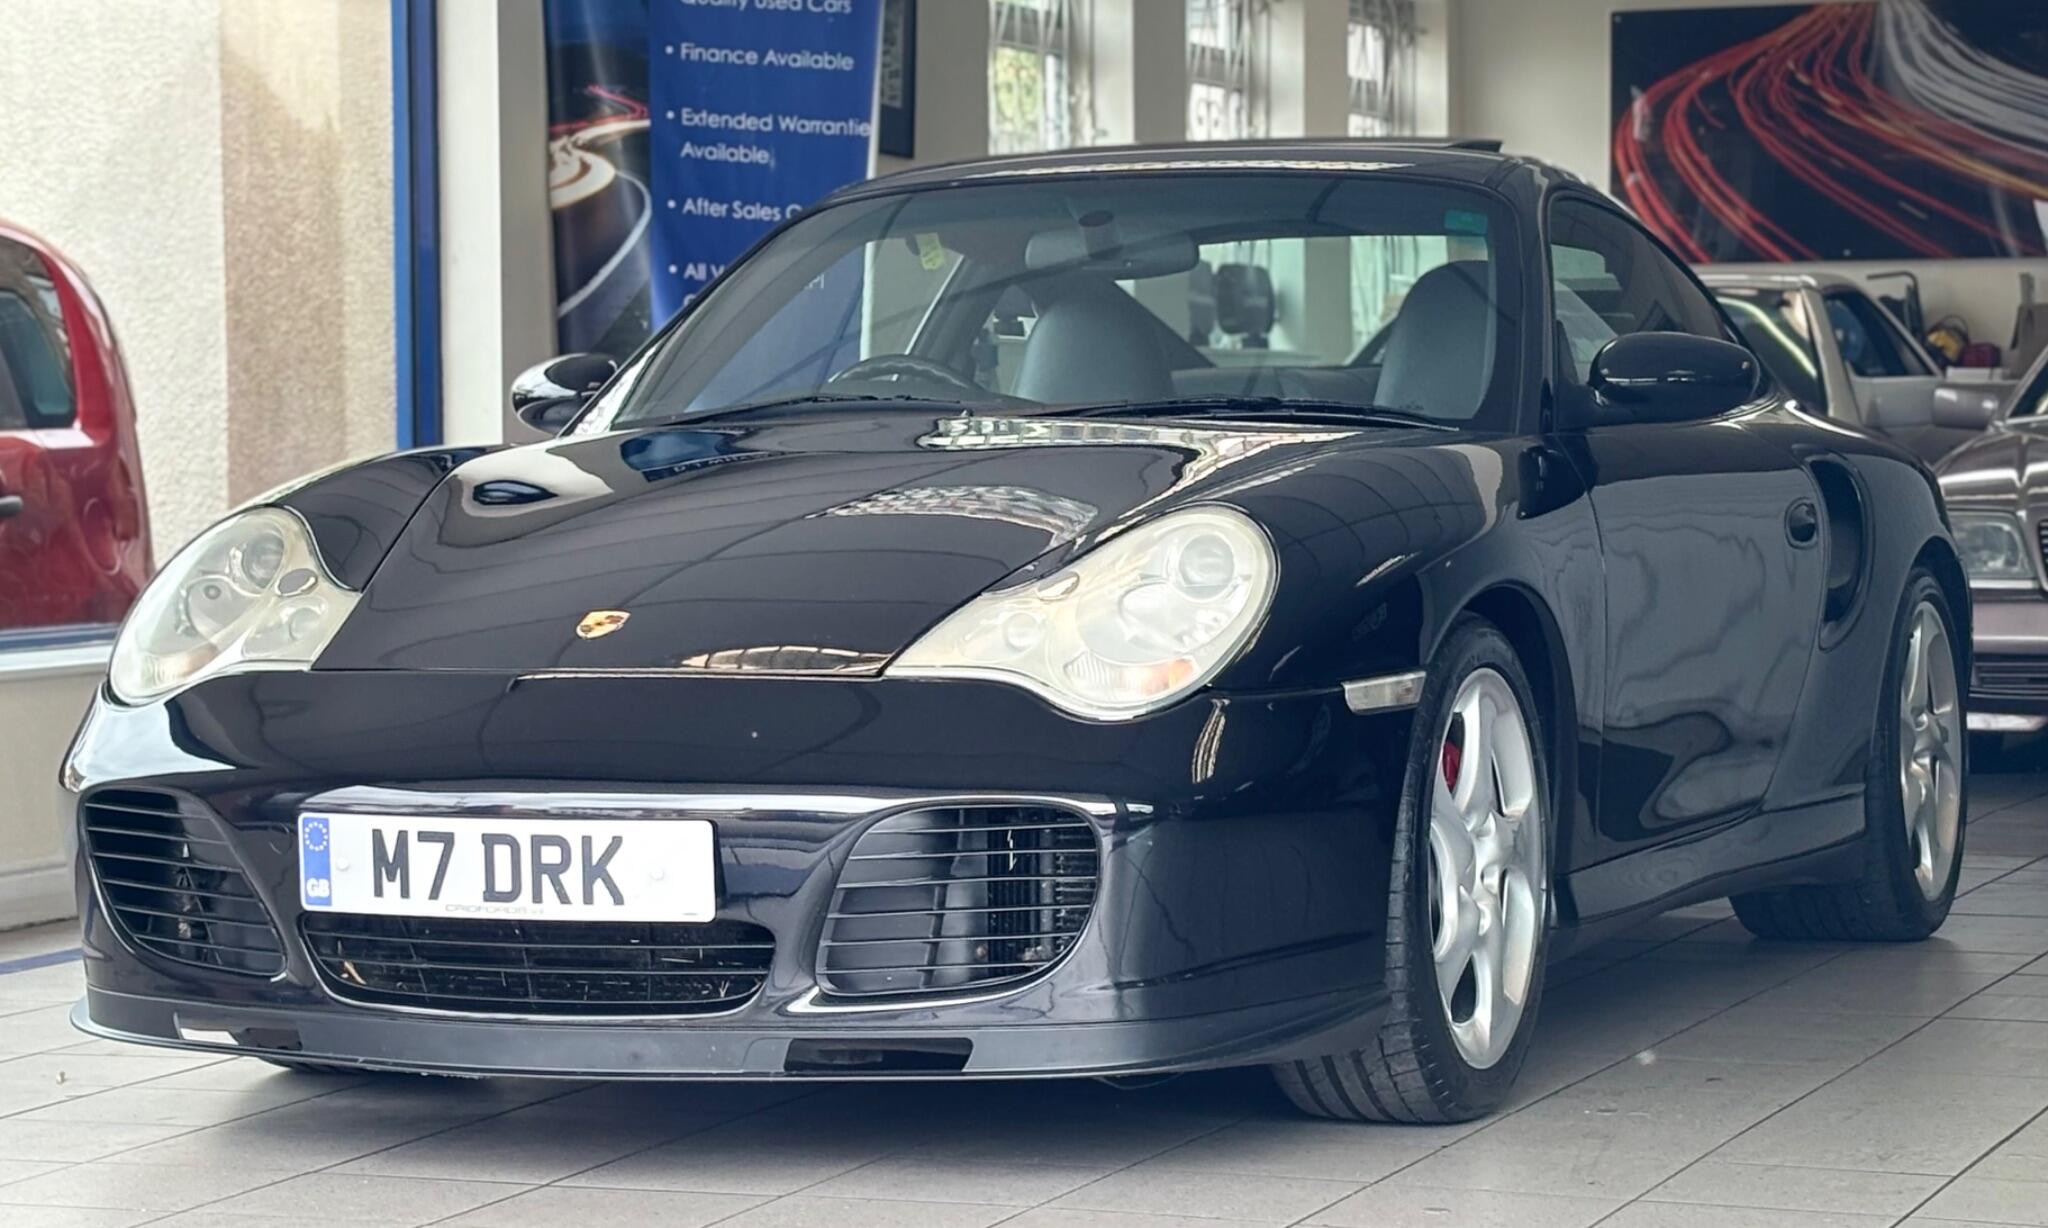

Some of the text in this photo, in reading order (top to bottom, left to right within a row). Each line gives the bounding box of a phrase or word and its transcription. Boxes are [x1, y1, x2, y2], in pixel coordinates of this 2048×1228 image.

[807, 0, 853, 14] Cars
[681, 42, 854, 70] Finance Available
[681, 108, 773, 131] Extended
[682, 198, 729, 217] After
[732, 200, 781, 221] Sales
[683, 262, 707, 280] All
[372, 829, 625, 905] M7 DRK
[306, 878, 330, 898] GB
